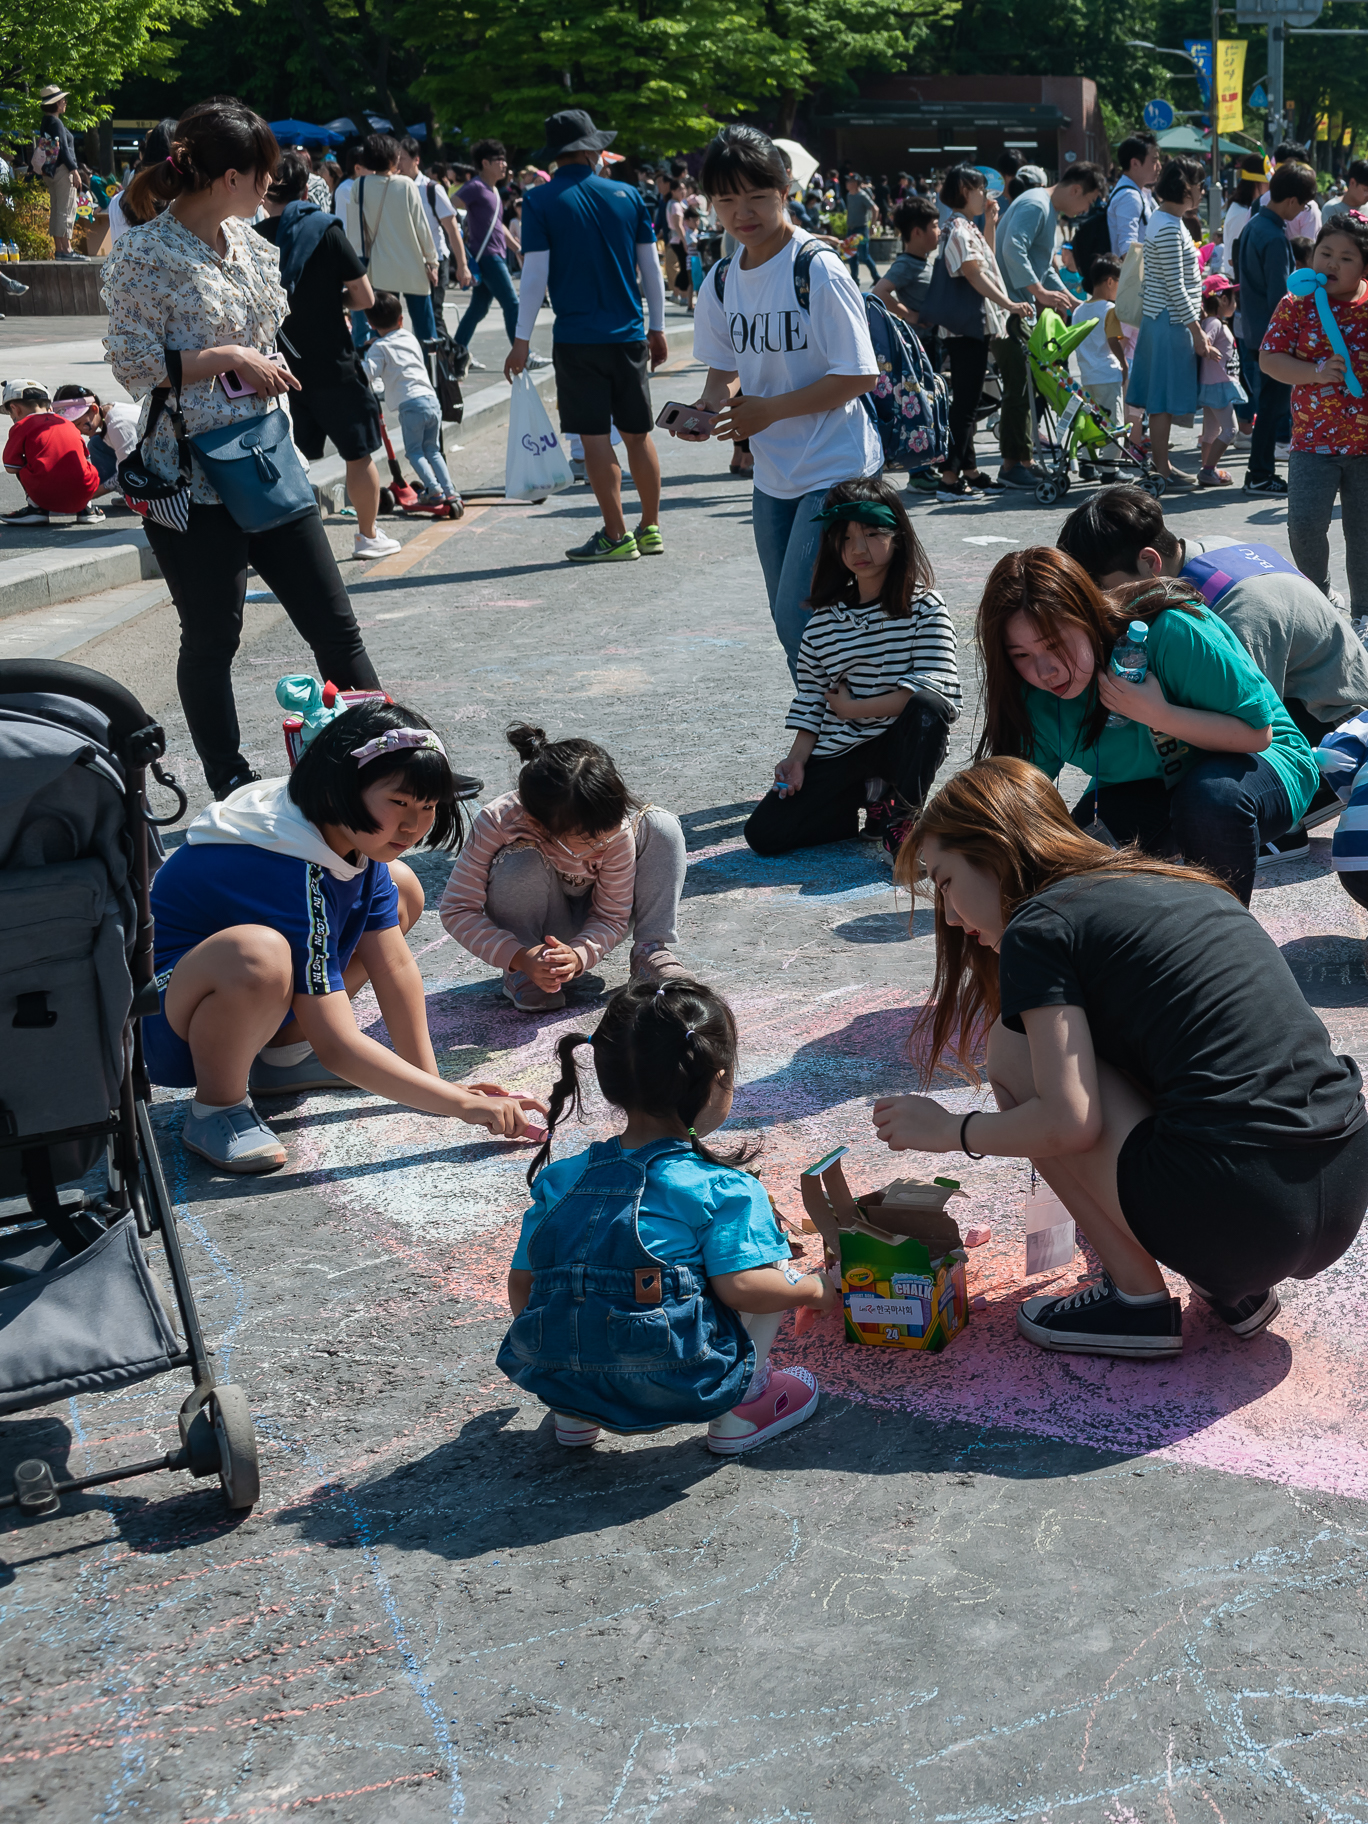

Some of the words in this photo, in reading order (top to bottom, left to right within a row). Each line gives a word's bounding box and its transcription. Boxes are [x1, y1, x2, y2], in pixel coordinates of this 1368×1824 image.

[895, 1284, 933, 1300] CHALK
[876, 1305, 913, 1315] 한국마사회
[885, 1328, 899, 1340] 24
